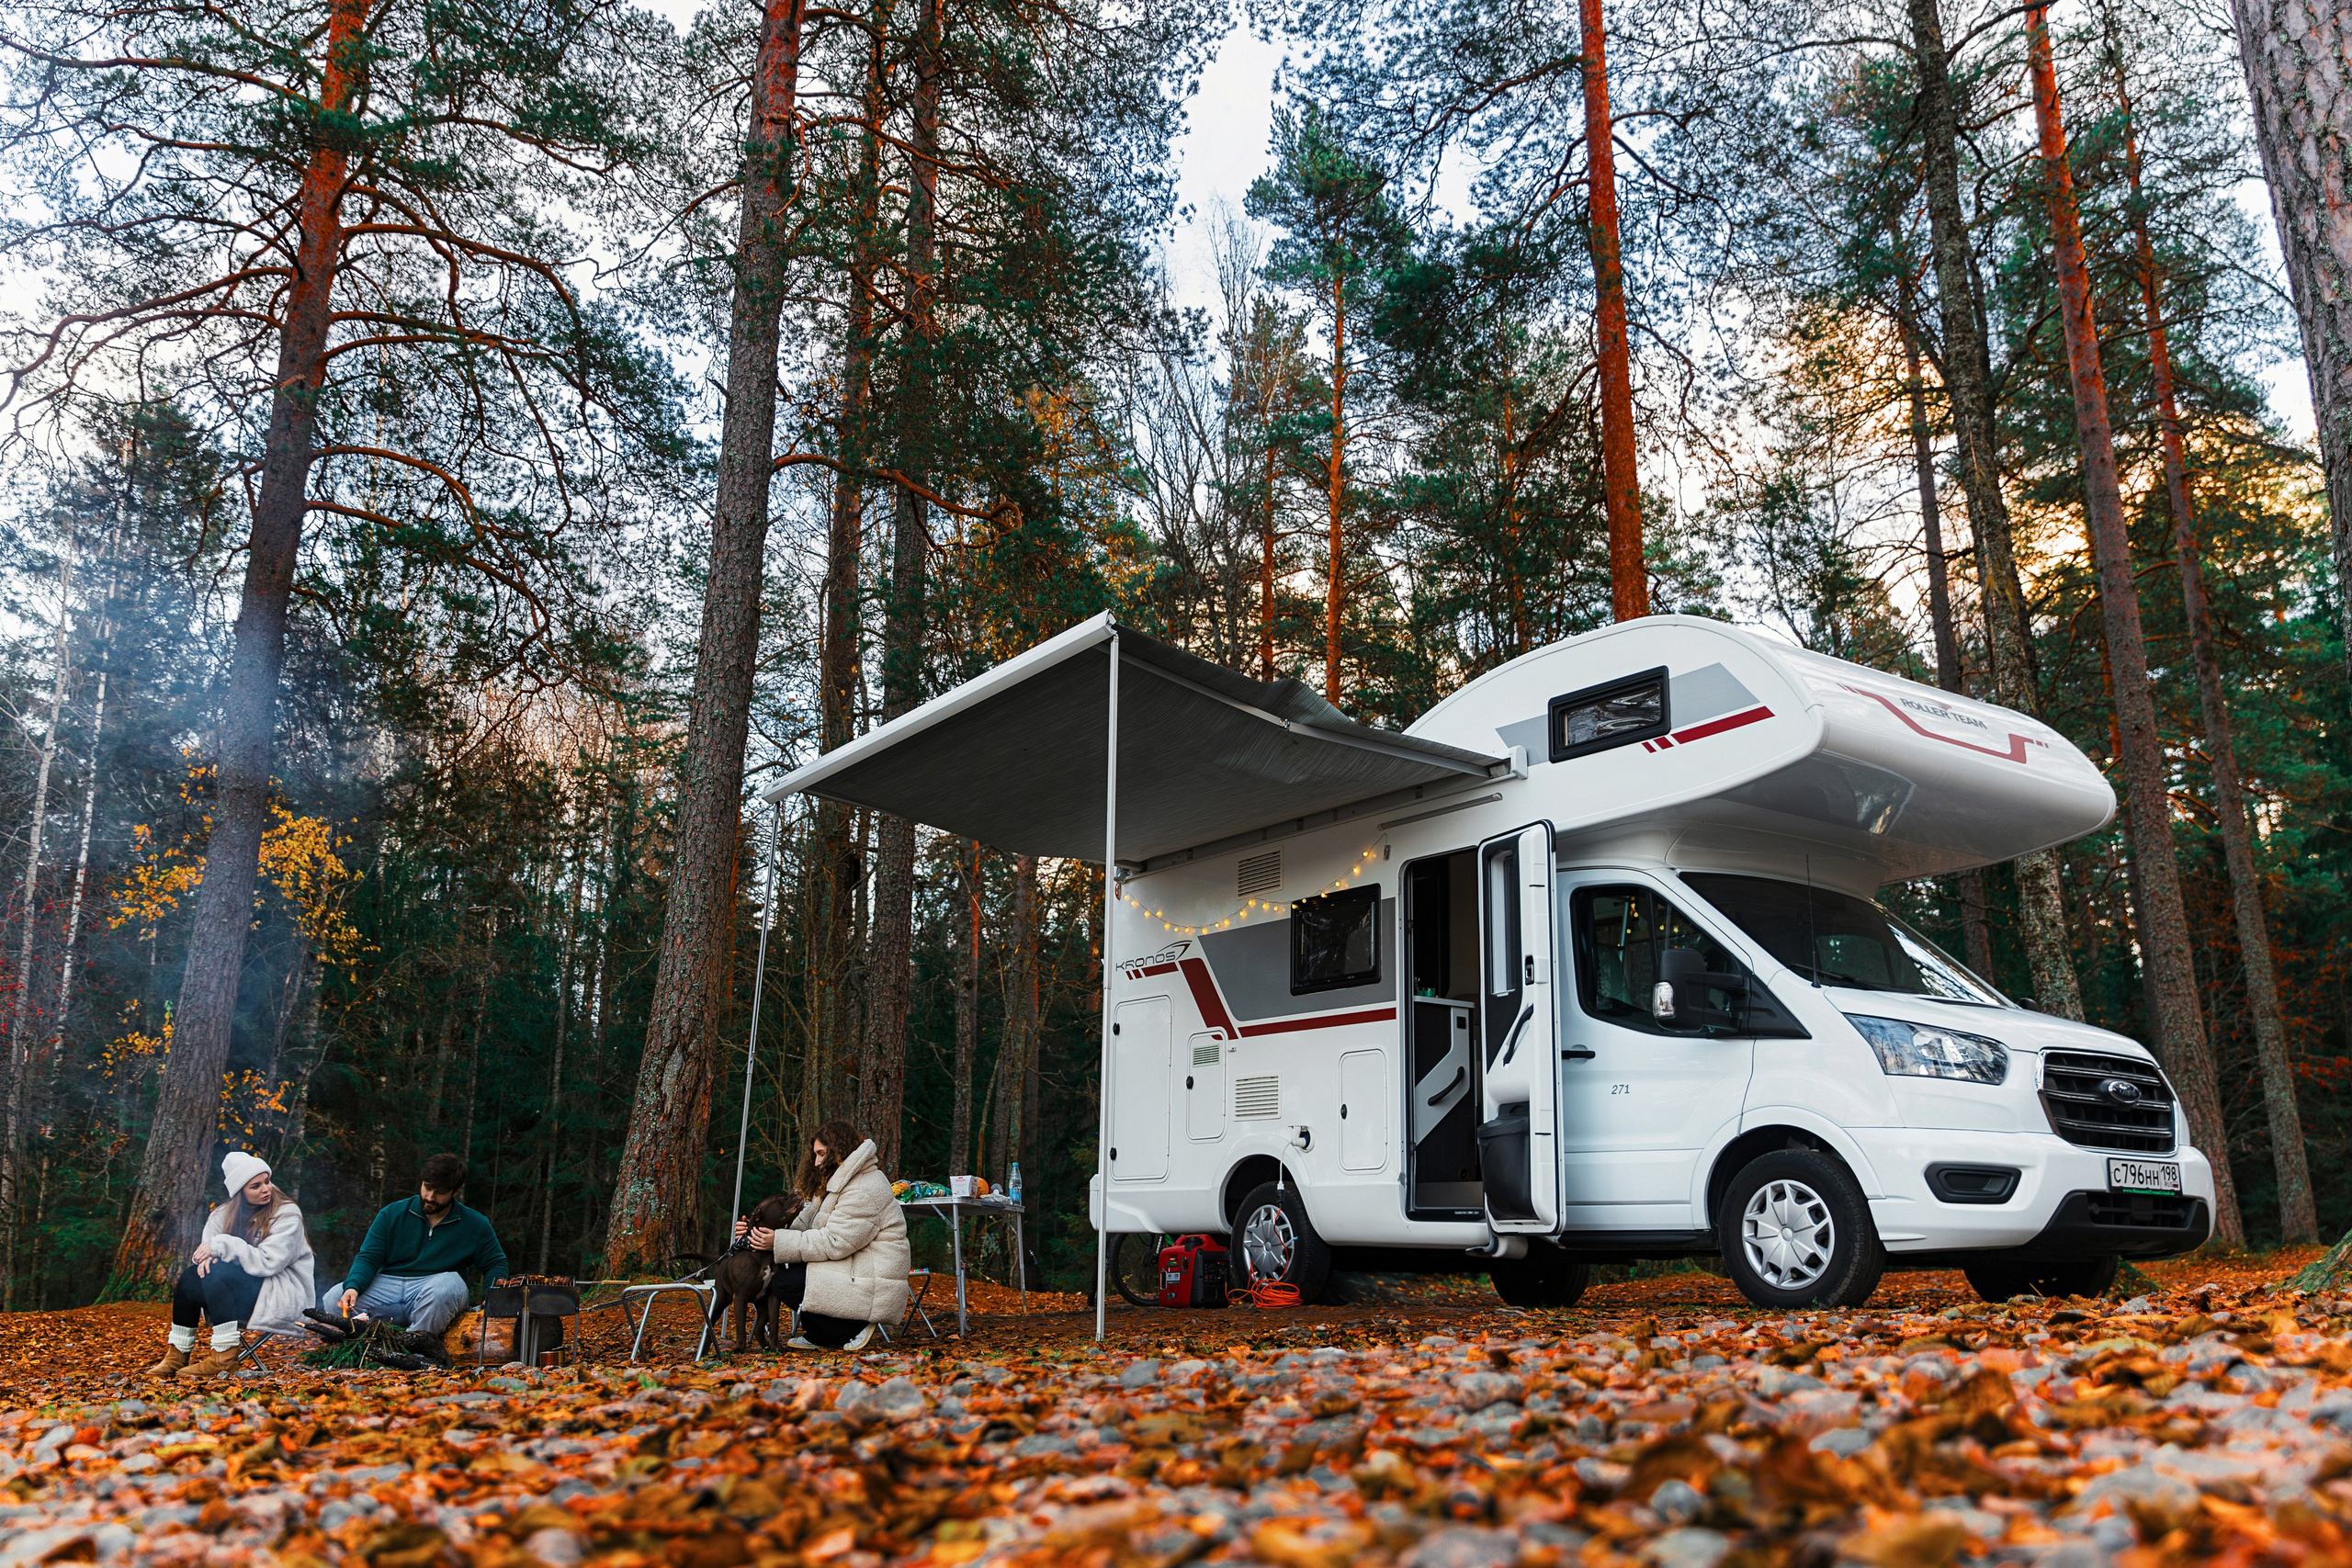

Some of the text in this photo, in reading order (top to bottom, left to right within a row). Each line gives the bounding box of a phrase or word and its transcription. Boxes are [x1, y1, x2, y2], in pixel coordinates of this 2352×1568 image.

[1899, 698, 1987, 729] ROLLER TEAM
[1611, 1084, 1630, 1095] 271
[2160, 1165, 2177, 1181] 198
